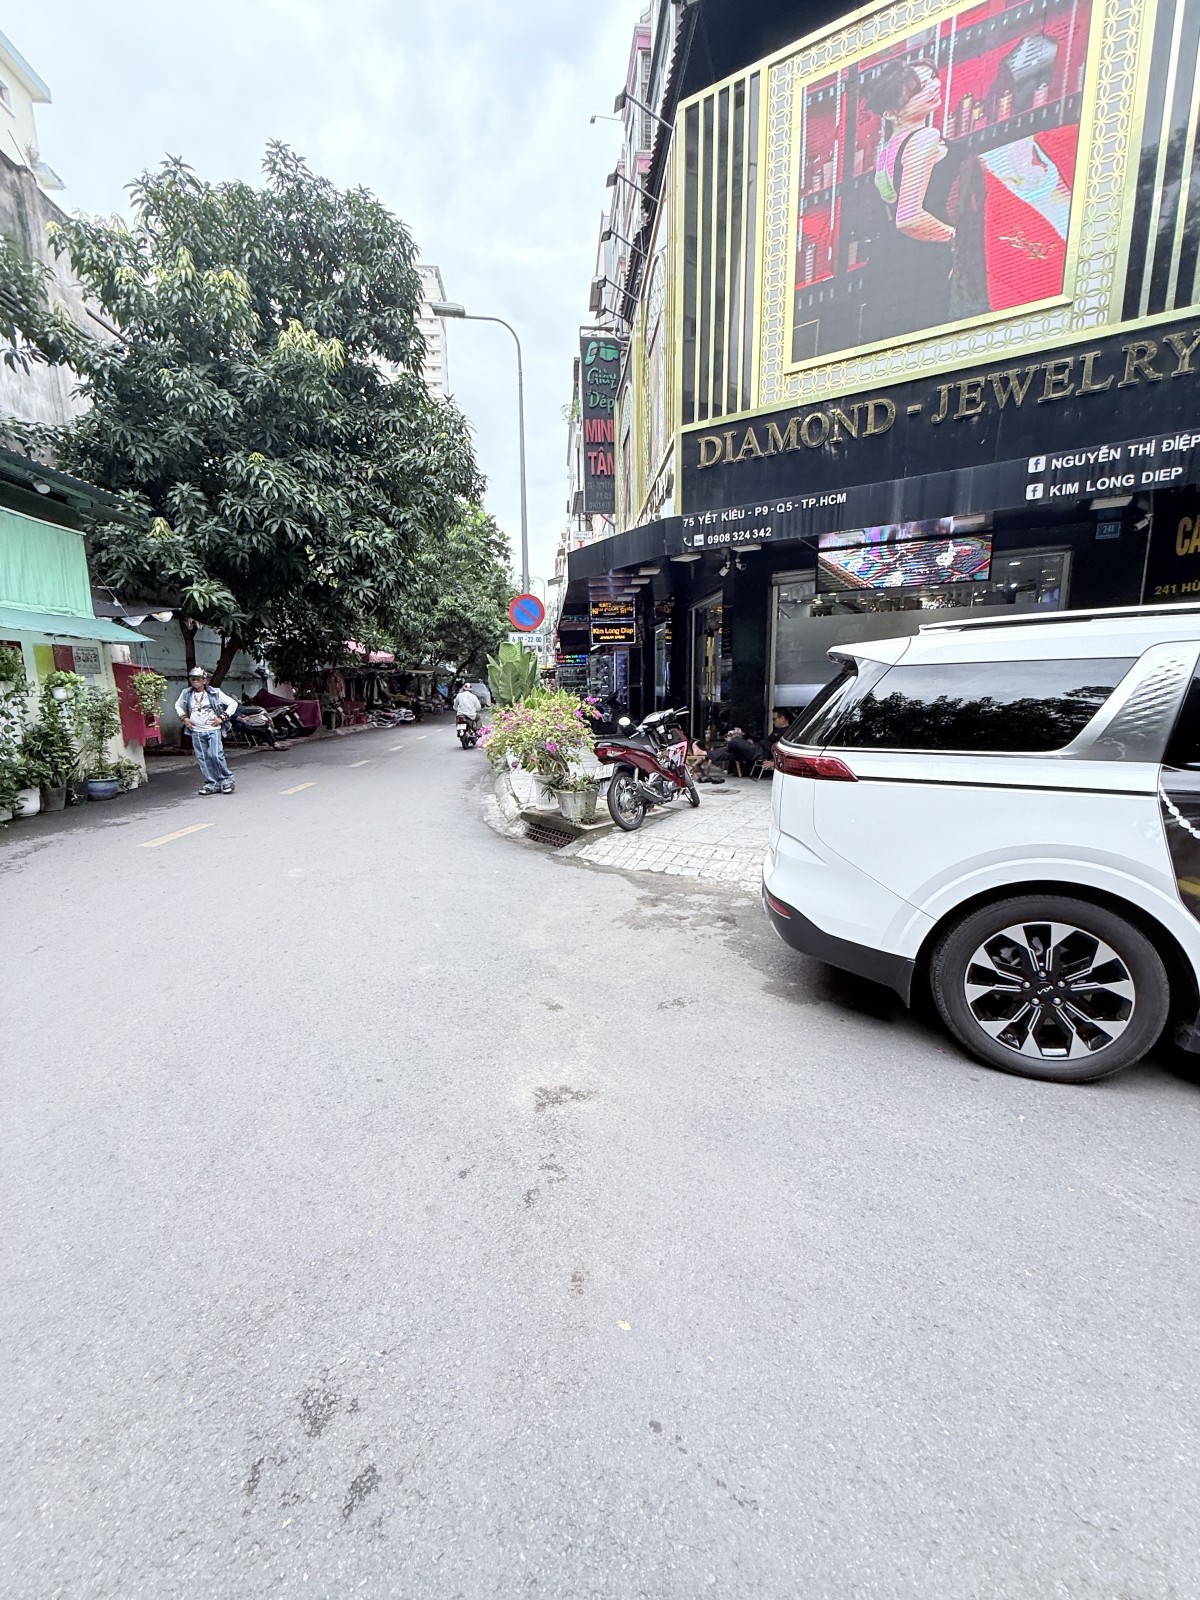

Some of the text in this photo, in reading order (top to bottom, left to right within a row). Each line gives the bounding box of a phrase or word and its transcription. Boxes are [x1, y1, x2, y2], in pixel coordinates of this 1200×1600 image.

[697, 398, 896, 469] DIAMOND
[930, 328, 1200, 424] JEWELRY
[1051, 445, 1121, 470] NGUYỄN
[1128, 440, 1155, 457] THỊ
[1050, 482, 1079, 497] KIM
[1086, 474, 1135, 492] LONG
[1141, 467, 1183, 485] DIEP
[683, 518, 695, 527] 75
[755, 505, 769, 517] P9
[801, 493, 847, 510] TP.HCM
[707, 533, 731, 545] 0908
[732, 530, 751, 542] 324
[752, 527, 772, 539] 342
[1153, 584, 1177, 595] 241
